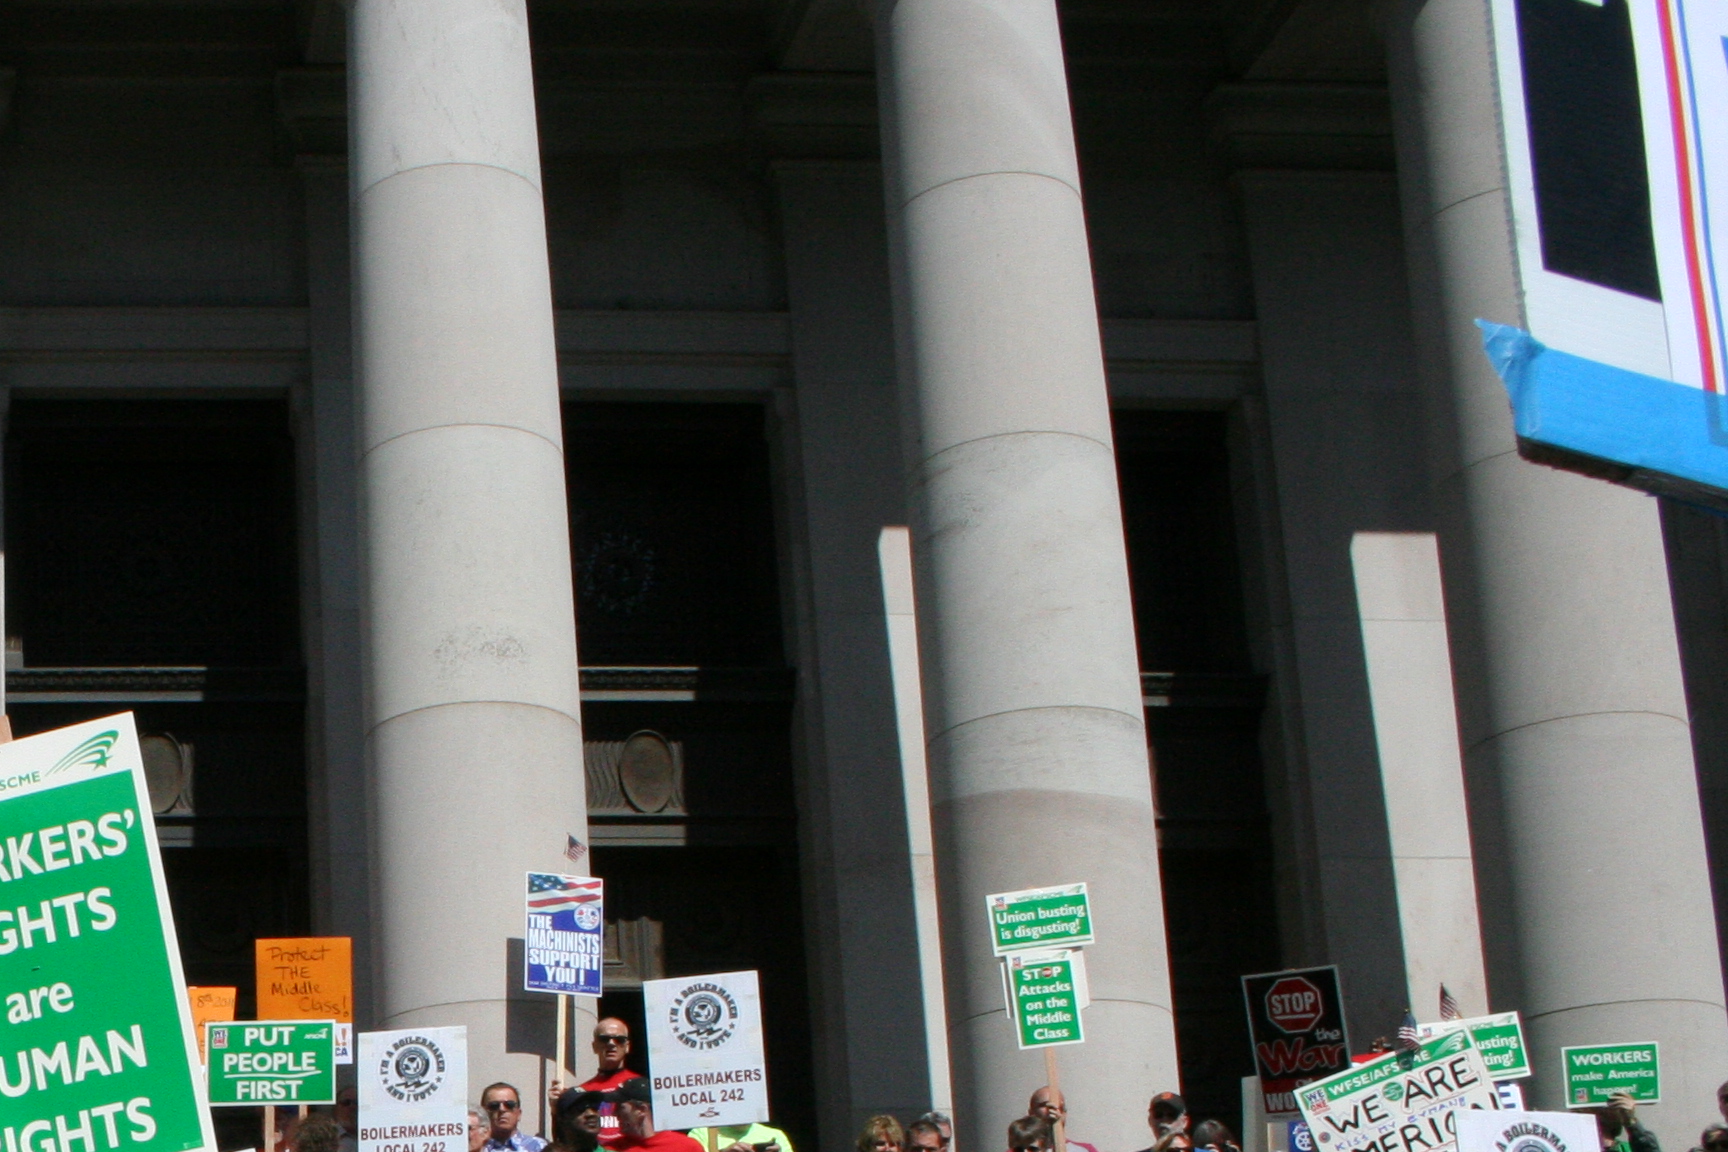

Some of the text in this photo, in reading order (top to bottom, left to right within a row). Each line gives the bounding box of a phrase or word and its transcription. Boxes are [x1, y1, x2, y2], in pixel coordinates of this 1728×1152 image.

[529, 914, 552, 929] THE
[996, 904, 1085, 925] Union busting
[1001, 919, 1081, 940] is disgusting!
[529, 929, 600, 954] MACHINISTS
[529, 949, 600, 970] SUPPORT
[275, 966, 311, 979] THE
[545, 966, 576, 984] YOU
[1022, 966, 1062, 981] STOP
[272, 983, 321, 996] Middle
[1019, 981, 1070, 997] Attacks
[6, 982, 75, 1025] are
[681, 983, 738, 1019] BOILERMAKER
[1026, 997, 1068, 1011] on the
[1271, 993, 1316, 1014] STOP
[1026, 1012, 1071, 1027] Middle
[244, 1027, 296, 1047] PUT
[1034, 1028, 1069, 1040] Class
[1314, 1027, 1341, 1042] the
[1476, 1035, 1518, 1049] usting
[223, 1052, 316, 1073] PEOPLE
[393, 1036, 445, 1073] BOILERMAKER
[1256, 1037, 1346, 1076] War
[1572, 1050, 1652, 1066] WORKERS
[654, 1068, 762, 1090] BOILERMAKERS
[1572, 1068, 1654, 1081] make America
[236, 1080, 303, 1101] FIRST
[671, 1088, 745, 1107] LOCAL 242
[1325, 1094, 1389, 1134] WE
[1404, 1056, 1477, 1108] ARE
[361, 1123, 463, 1140] BOILERMAKERS
[1495, 1140, 1507, 1151] A
